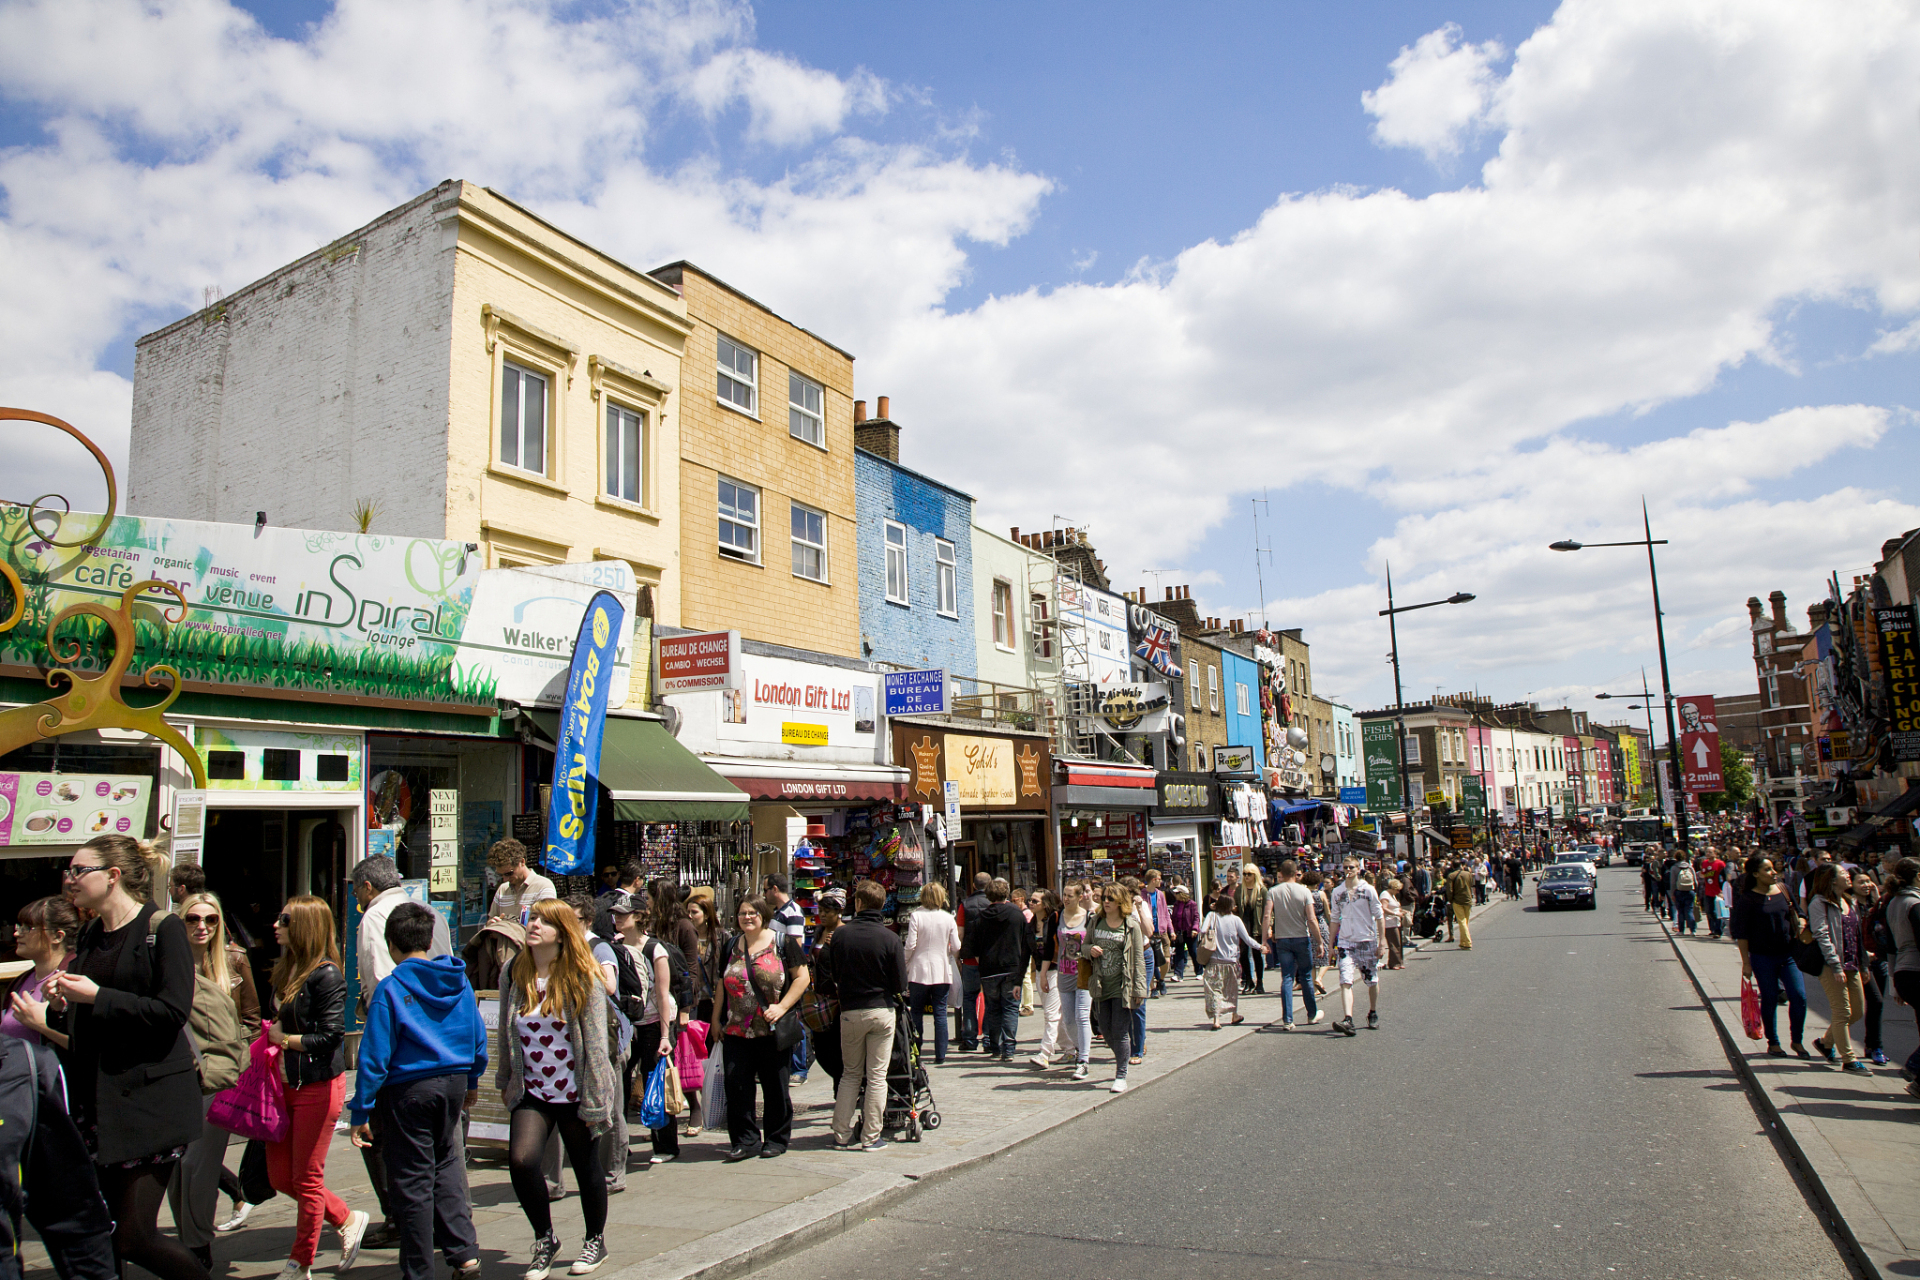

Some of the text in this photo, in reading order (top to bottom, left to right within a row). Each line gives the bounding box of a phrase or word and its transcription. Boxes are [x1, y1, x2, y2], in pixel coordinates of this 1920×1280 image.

[80, 544, 277, 585] vegetarian organic music event
[592, 566, 626, 590] 250
[74, 562, 133, 590] café
[205, 584, 274, 610] venue
[1877, 610, 1909, 621] Blue
[366, 630, 415, 649] lounge
[1099, 630, 1111, 651] CAT
[662, 639, 728, 658] BUREAU DE CHANGE
[503, 654, 533, 667] Canal
[665, 660, 691, 670] CAMBIO
[696, 657, 726, 667] WECHSEL
[665, 676, 725, 689] 0% COMMISSION
[886, 671, 942, 686] MONEY EXCHANGE
[1885, 631, 1912, 731] PIERCING
[576, 647, 600, 738] BOAT
[754, 678, 850, 711] London Gift Ltd
[889, 685, 939, 695] BUREAU
[906, 695, 922, 703] DE
[889, 703, 940, 713] CHANGE
[782, 728, 829, 740] BUREAU DE CHANGE
[1363, 725, 1393, 735] FISH
[1218, 754, 1250, 765] Martens
[1688, 772, 1720, 782] 2 min
[781, 783, 847, 794] LONDON GIFT LTD
[1000, 789, 1014, 799] Goods
[432, 791, 456, 800] NEXT
[433, 803, 455, 812] TRIP
[898, 811, 914, 819] LONDON
[432, 816, 444, 828] 12
[432, 844, 440, 860] 2
[895, 851, 923, 859] LONDON
[1216, 847, 1237, 859] Sale
[432, 869, 441, 885] 4
